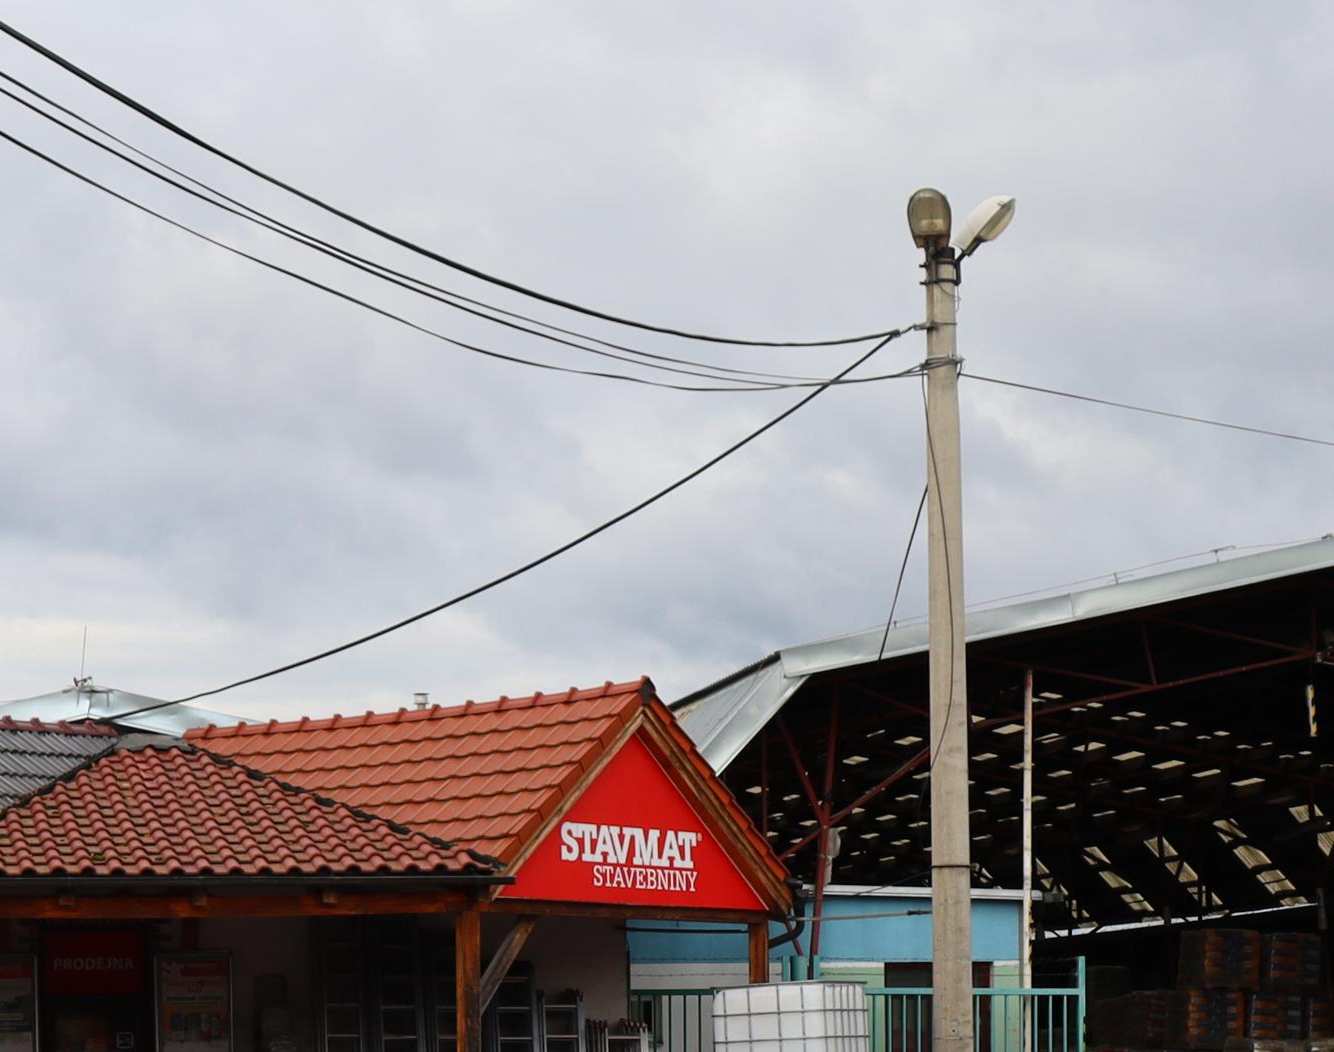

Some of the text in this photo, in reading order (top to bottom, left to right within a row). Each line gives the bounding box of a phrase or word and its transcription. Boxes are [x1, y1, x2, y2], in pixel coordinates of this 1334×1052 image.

[560, 821, 698, 869] STAVMAT
[593, 865, 698, 892] STAVEBNINY
[53, 958, 134, 971] PRODEJNA
